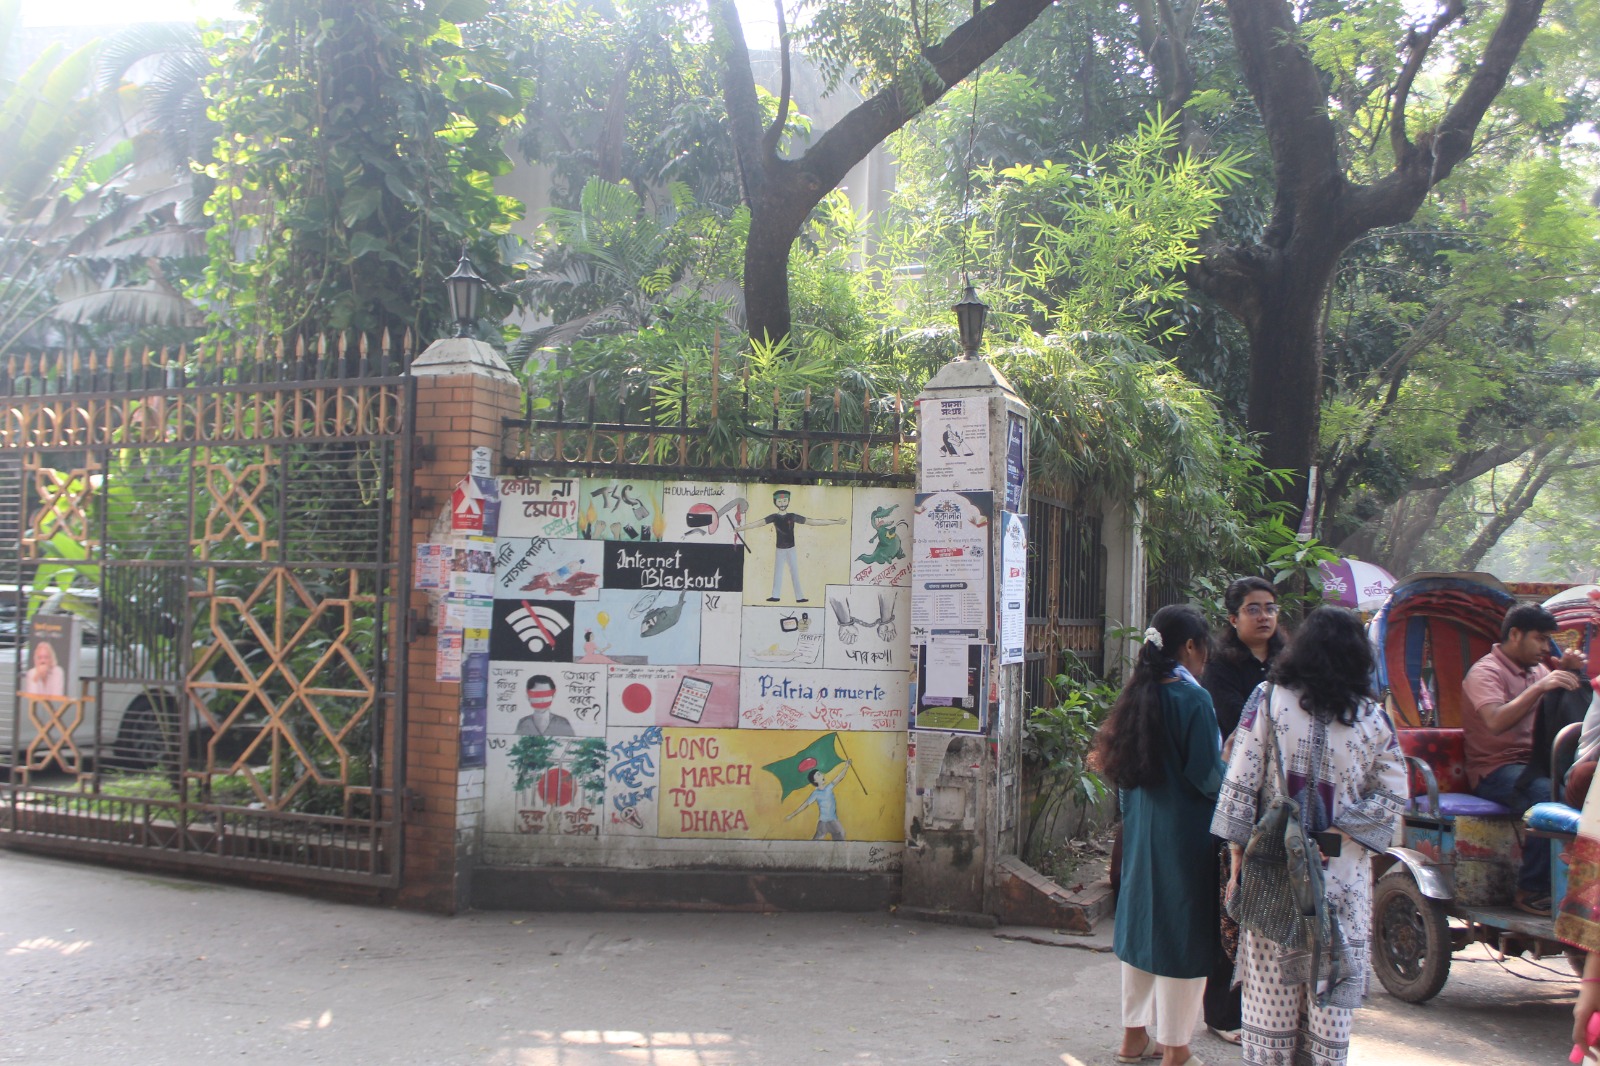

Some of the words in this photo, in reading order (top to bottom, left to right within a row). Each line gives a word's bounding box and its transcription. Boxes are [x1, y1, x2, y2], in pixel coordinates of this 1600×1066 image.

[550, 478, 574, 498] না
[493, 542, 515, 568] পানি
[616, 549, 683, 569] Internet
[500, 556, 533, 588] লাগবে
[641, 568, 723, 589] Blackout
[845, 649, 870, 664] আর
[758, 674, 813, 699] Patria
[834, 685, 886, 700] muerte
[664, 736, 720, 760] LONG
[681, 764, 753, 788] MARCH
[669, 788, 697, 808] TO
[680, 810, 750, 832] DHAKA
